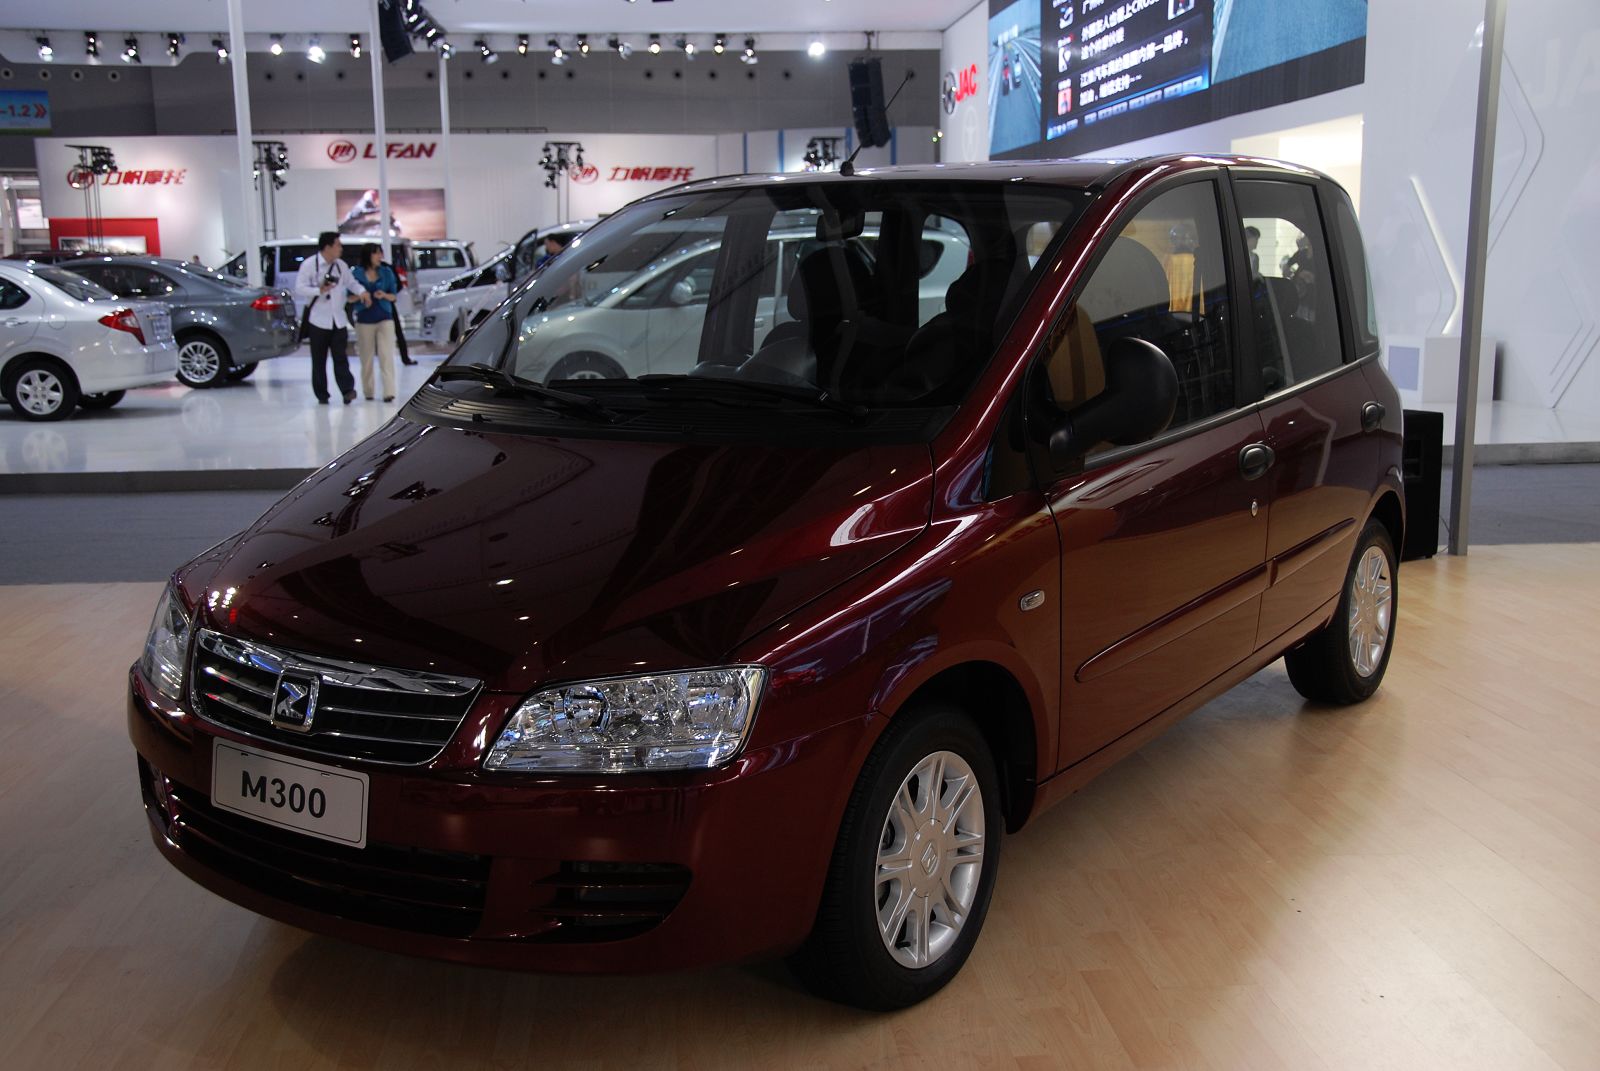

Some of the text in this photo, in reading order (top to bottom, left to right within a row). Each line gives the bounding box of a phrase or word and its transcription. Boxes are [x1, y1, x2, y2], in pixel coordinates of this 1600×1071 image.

[955, 64, 977, 102] JAC
[363, 142, 436, 159] LFAN
[102, 168, 187, 185] 力帆摩托
[608, 166, 694, 182] 力帆摩托
[241, 770, 326, 818] M300
